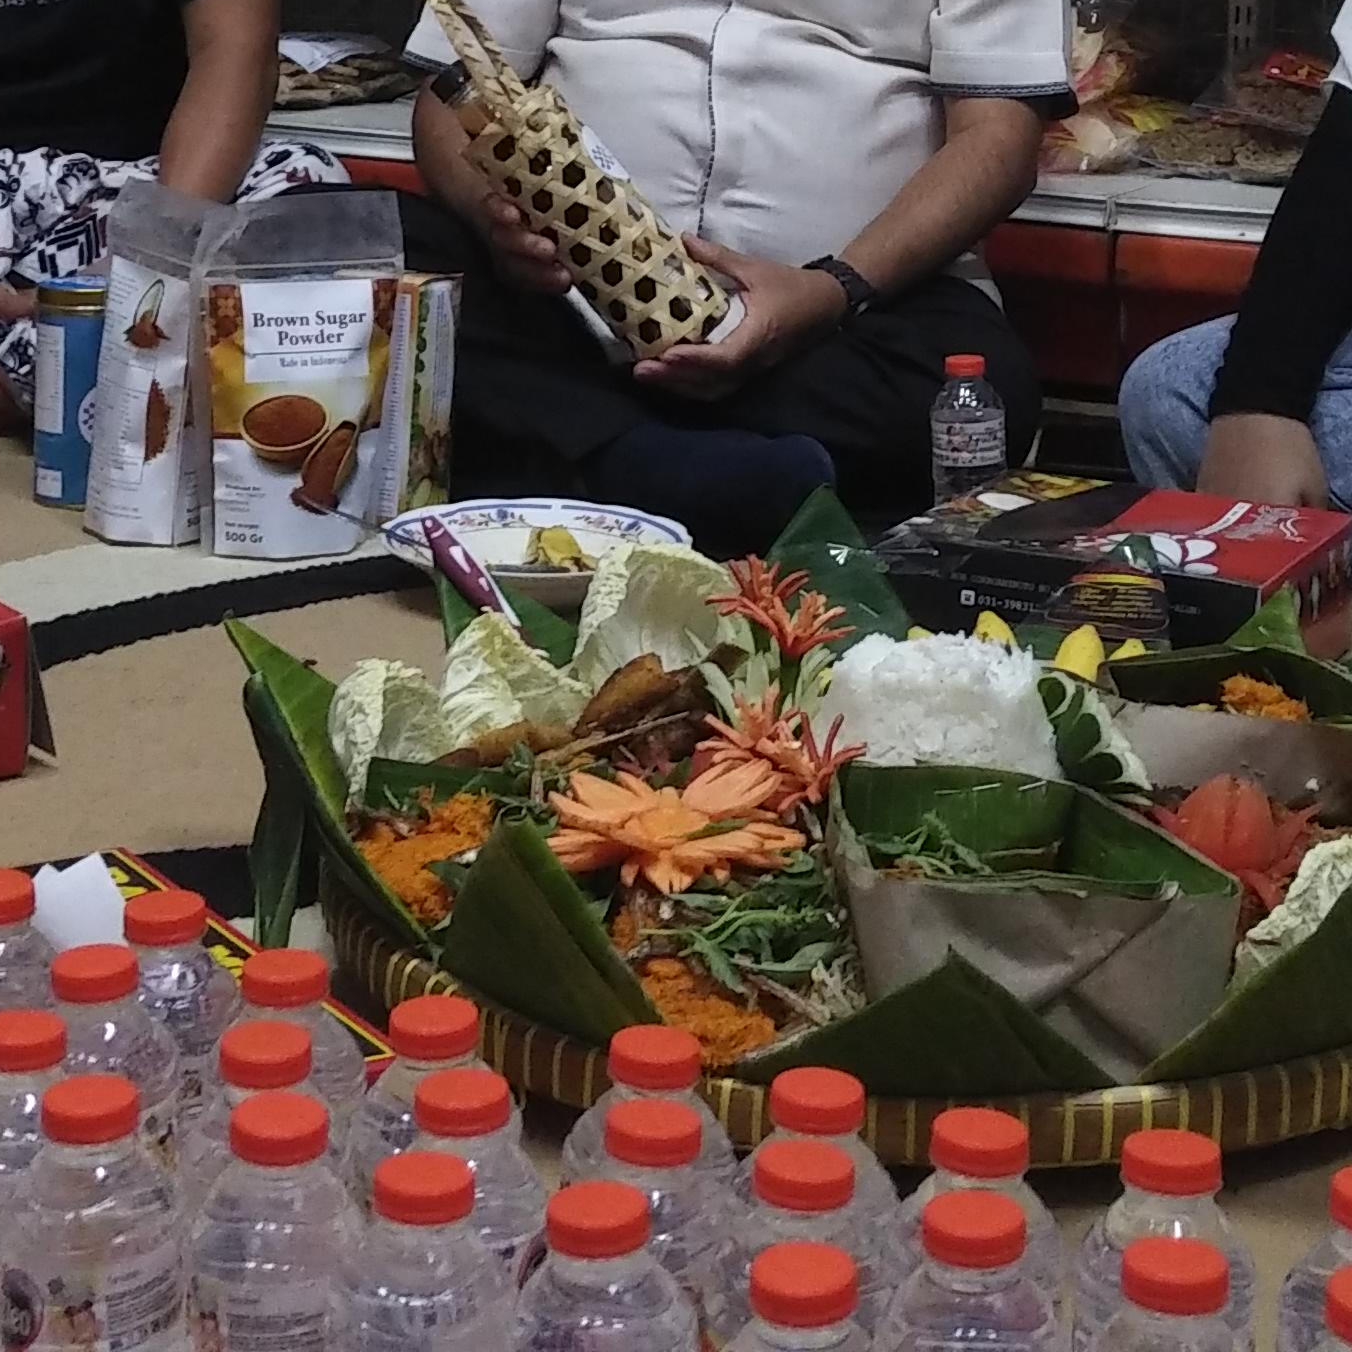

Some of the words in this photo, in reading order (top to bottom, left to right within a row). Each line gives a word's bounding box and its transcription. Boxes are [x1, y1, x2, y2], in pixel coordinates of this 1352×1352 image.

[251, 312, 310, 328] Brown
[314, 310, 367, 329] Sugar
[277, 329, 345, 346] Powder
[224, 531, 247, 543] 500
[249, 533, 264, 544] Gr
